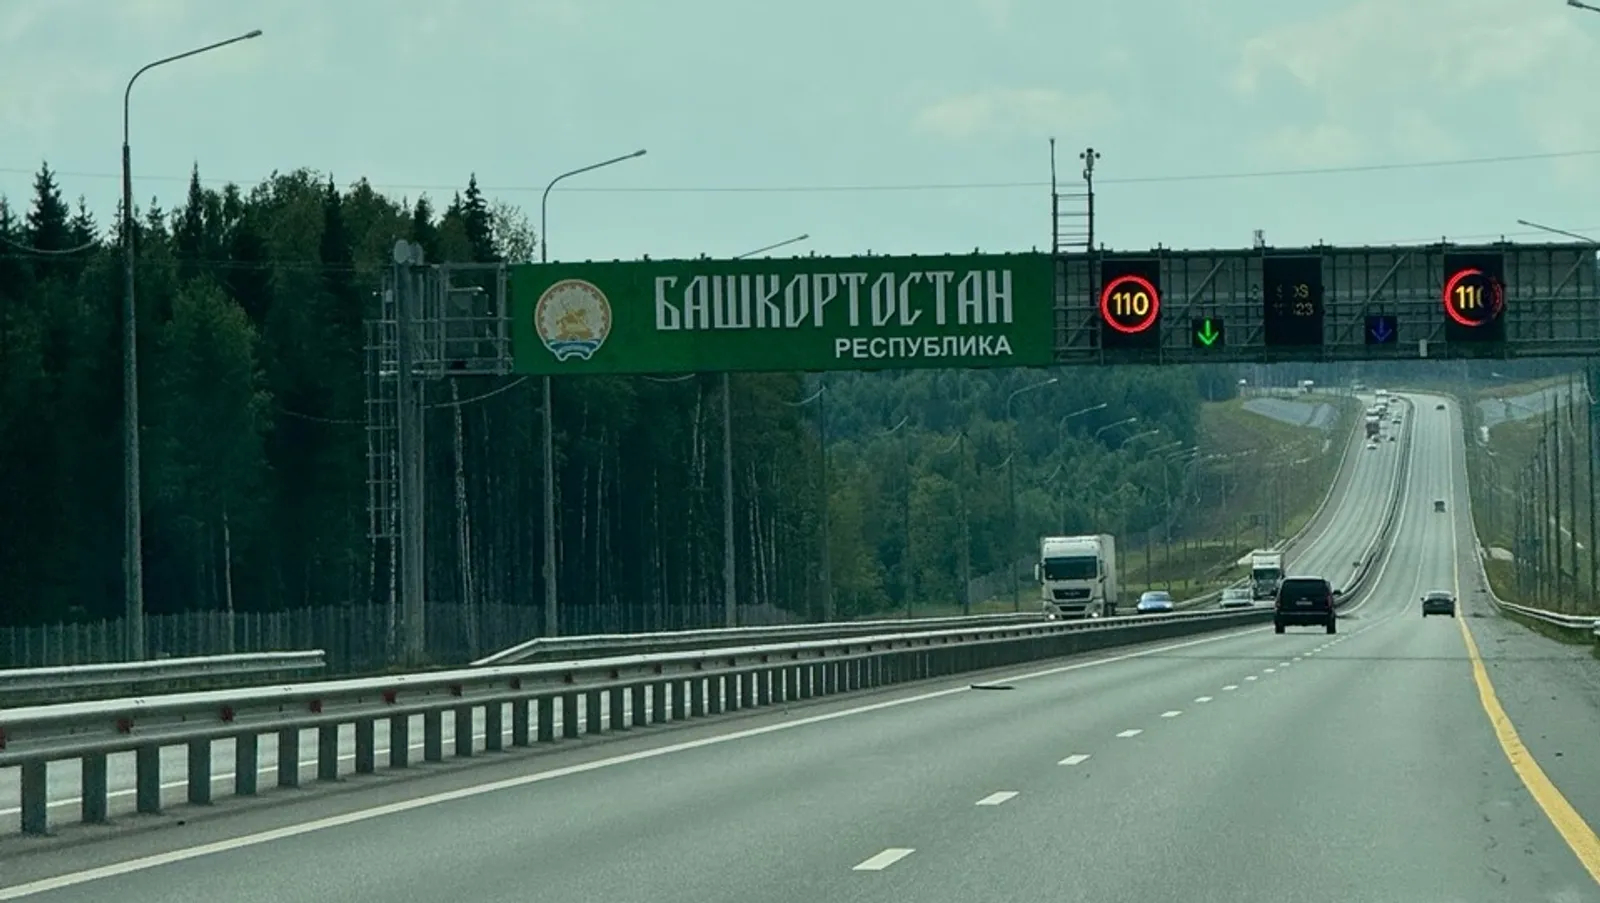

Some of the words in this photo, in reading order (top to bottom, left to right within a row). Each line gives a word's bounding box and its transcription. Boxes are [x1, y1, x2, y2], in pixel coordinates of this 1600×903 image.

[655, 270, 1013, 330] БАШКОРТОСТАН
[1112, 292, 1149, 316] 110
[834, 335, 1012, 359] РЕСПУБЛИКА
